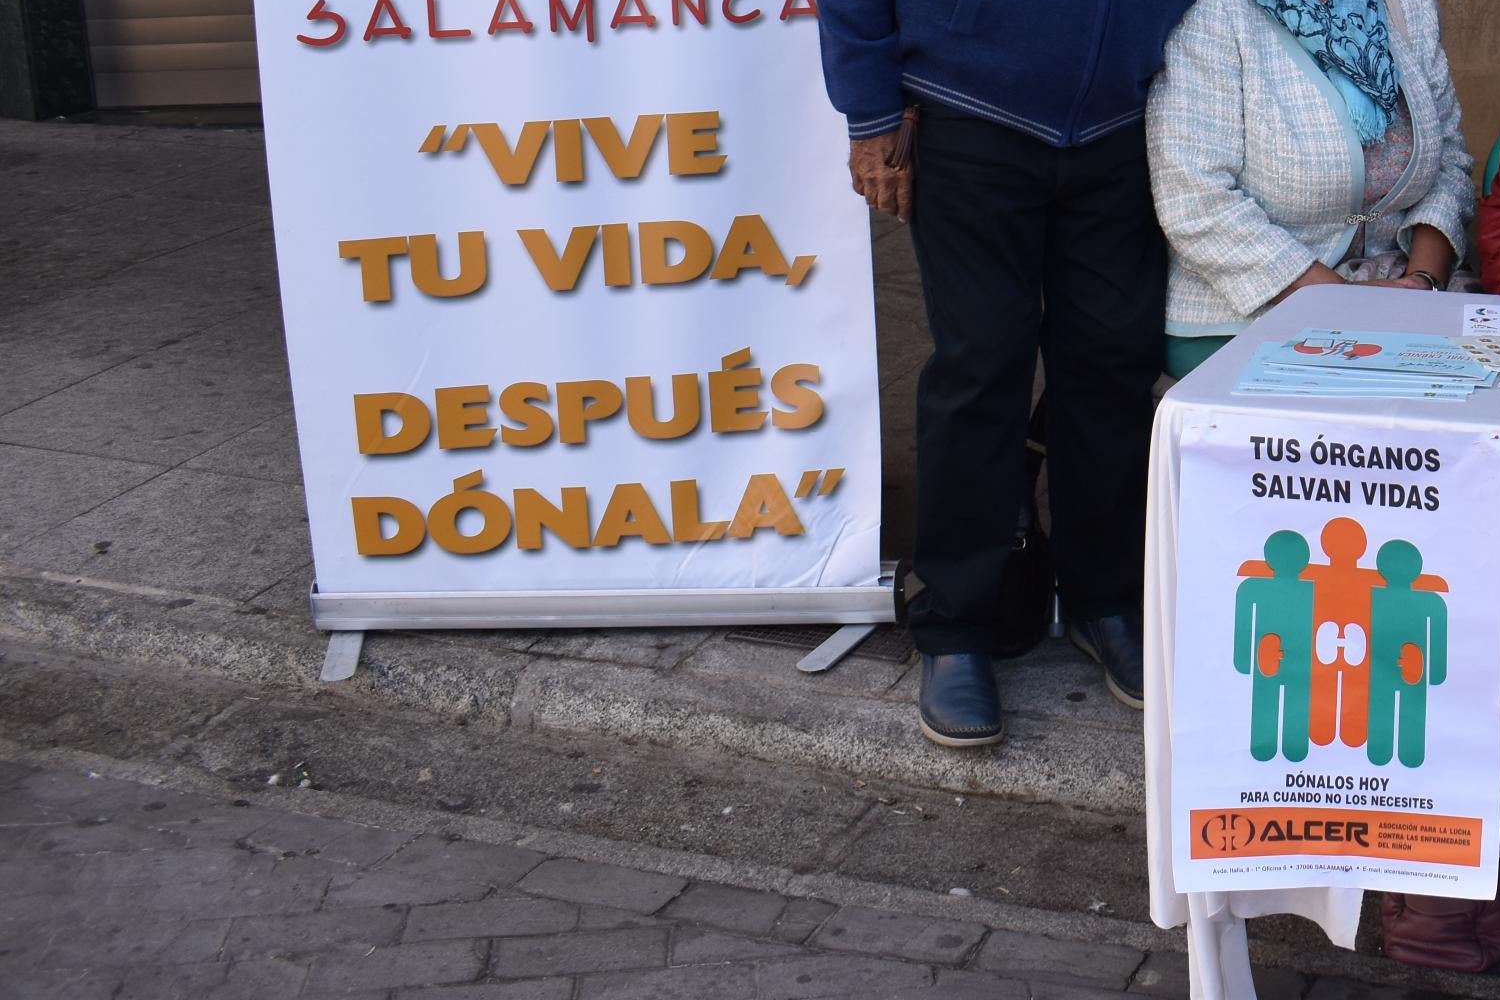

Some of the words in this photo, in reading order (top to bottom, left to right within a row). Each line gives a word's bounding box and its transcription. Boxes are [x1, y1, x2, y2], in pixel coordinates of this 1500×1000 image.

[338, 231, 487, 302] TU
[517, 214, 817, 291] VIDA,
[354, 347, 824, 455] DESPUÉS
[1250, 436, 1300, 463] TUS
[1311, 434, 1440, 472] ÓRGANOS
[1252, 472, 1350, 503] SALVAN
[1361, 481, 1439, 512] VIDAS
[1285, 770, 1354, 790] DÓNALOS
[1359, 777, 1390, 792] HOY
[1240, 792, 1270, 803] PARA
[1273, 792, 1321, 804] CUANDO
[1325, 793, 1342, 804] NO
[1345, 794, 1367, 806] LOS
[1371, 796, 1434, 810] NECESITES
[1259, 820, 1370, 848] ALCER
[1378, 821, 1418, 833] ASOCIACIÓN
[1420, 825, 1437, 834] PARA
[1439, 827, 1448, 835] LA
[1450, 827, 1472, 836] LUCHA
[1378, 832, 1405, 840] CONTRA
[1406, 834, 1419, 842] LAS
[1420, 835, 1471, 846] ENFERMEDADES
[1315, 863, 1353, 872] SALAMANCA
